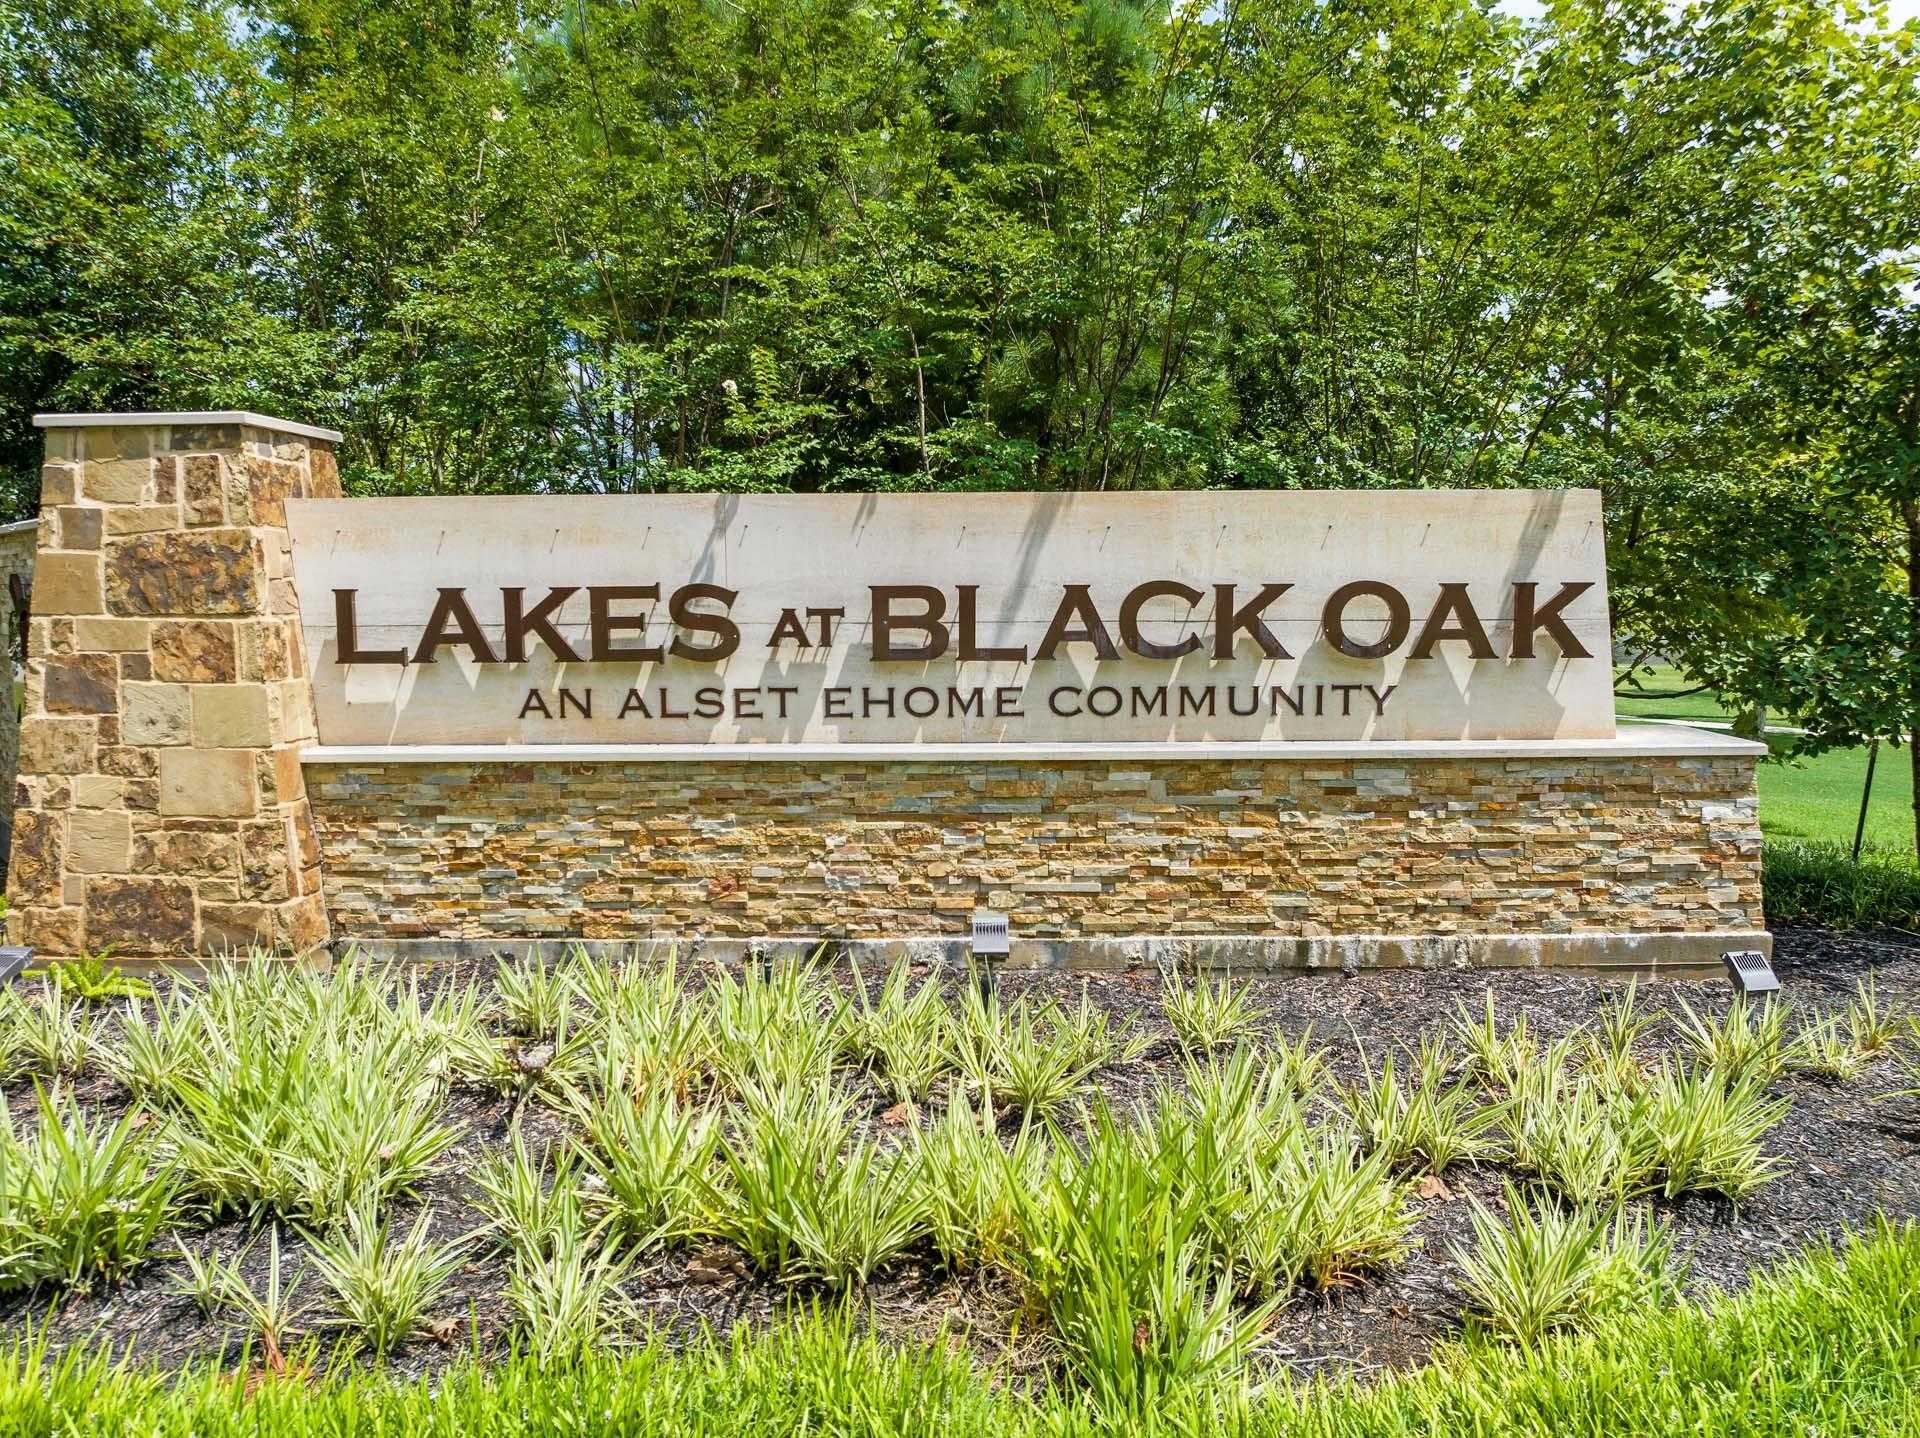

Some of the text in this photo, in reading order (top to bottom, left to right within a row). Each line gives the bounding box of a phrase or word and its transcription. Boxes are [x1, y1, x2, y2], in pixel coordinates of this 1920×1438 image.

[331, 580, 1595, 667] LAKES AT BLACK OAK
[517, 684, 1398, 719] AN ALSET EHOME COMMUNITY
